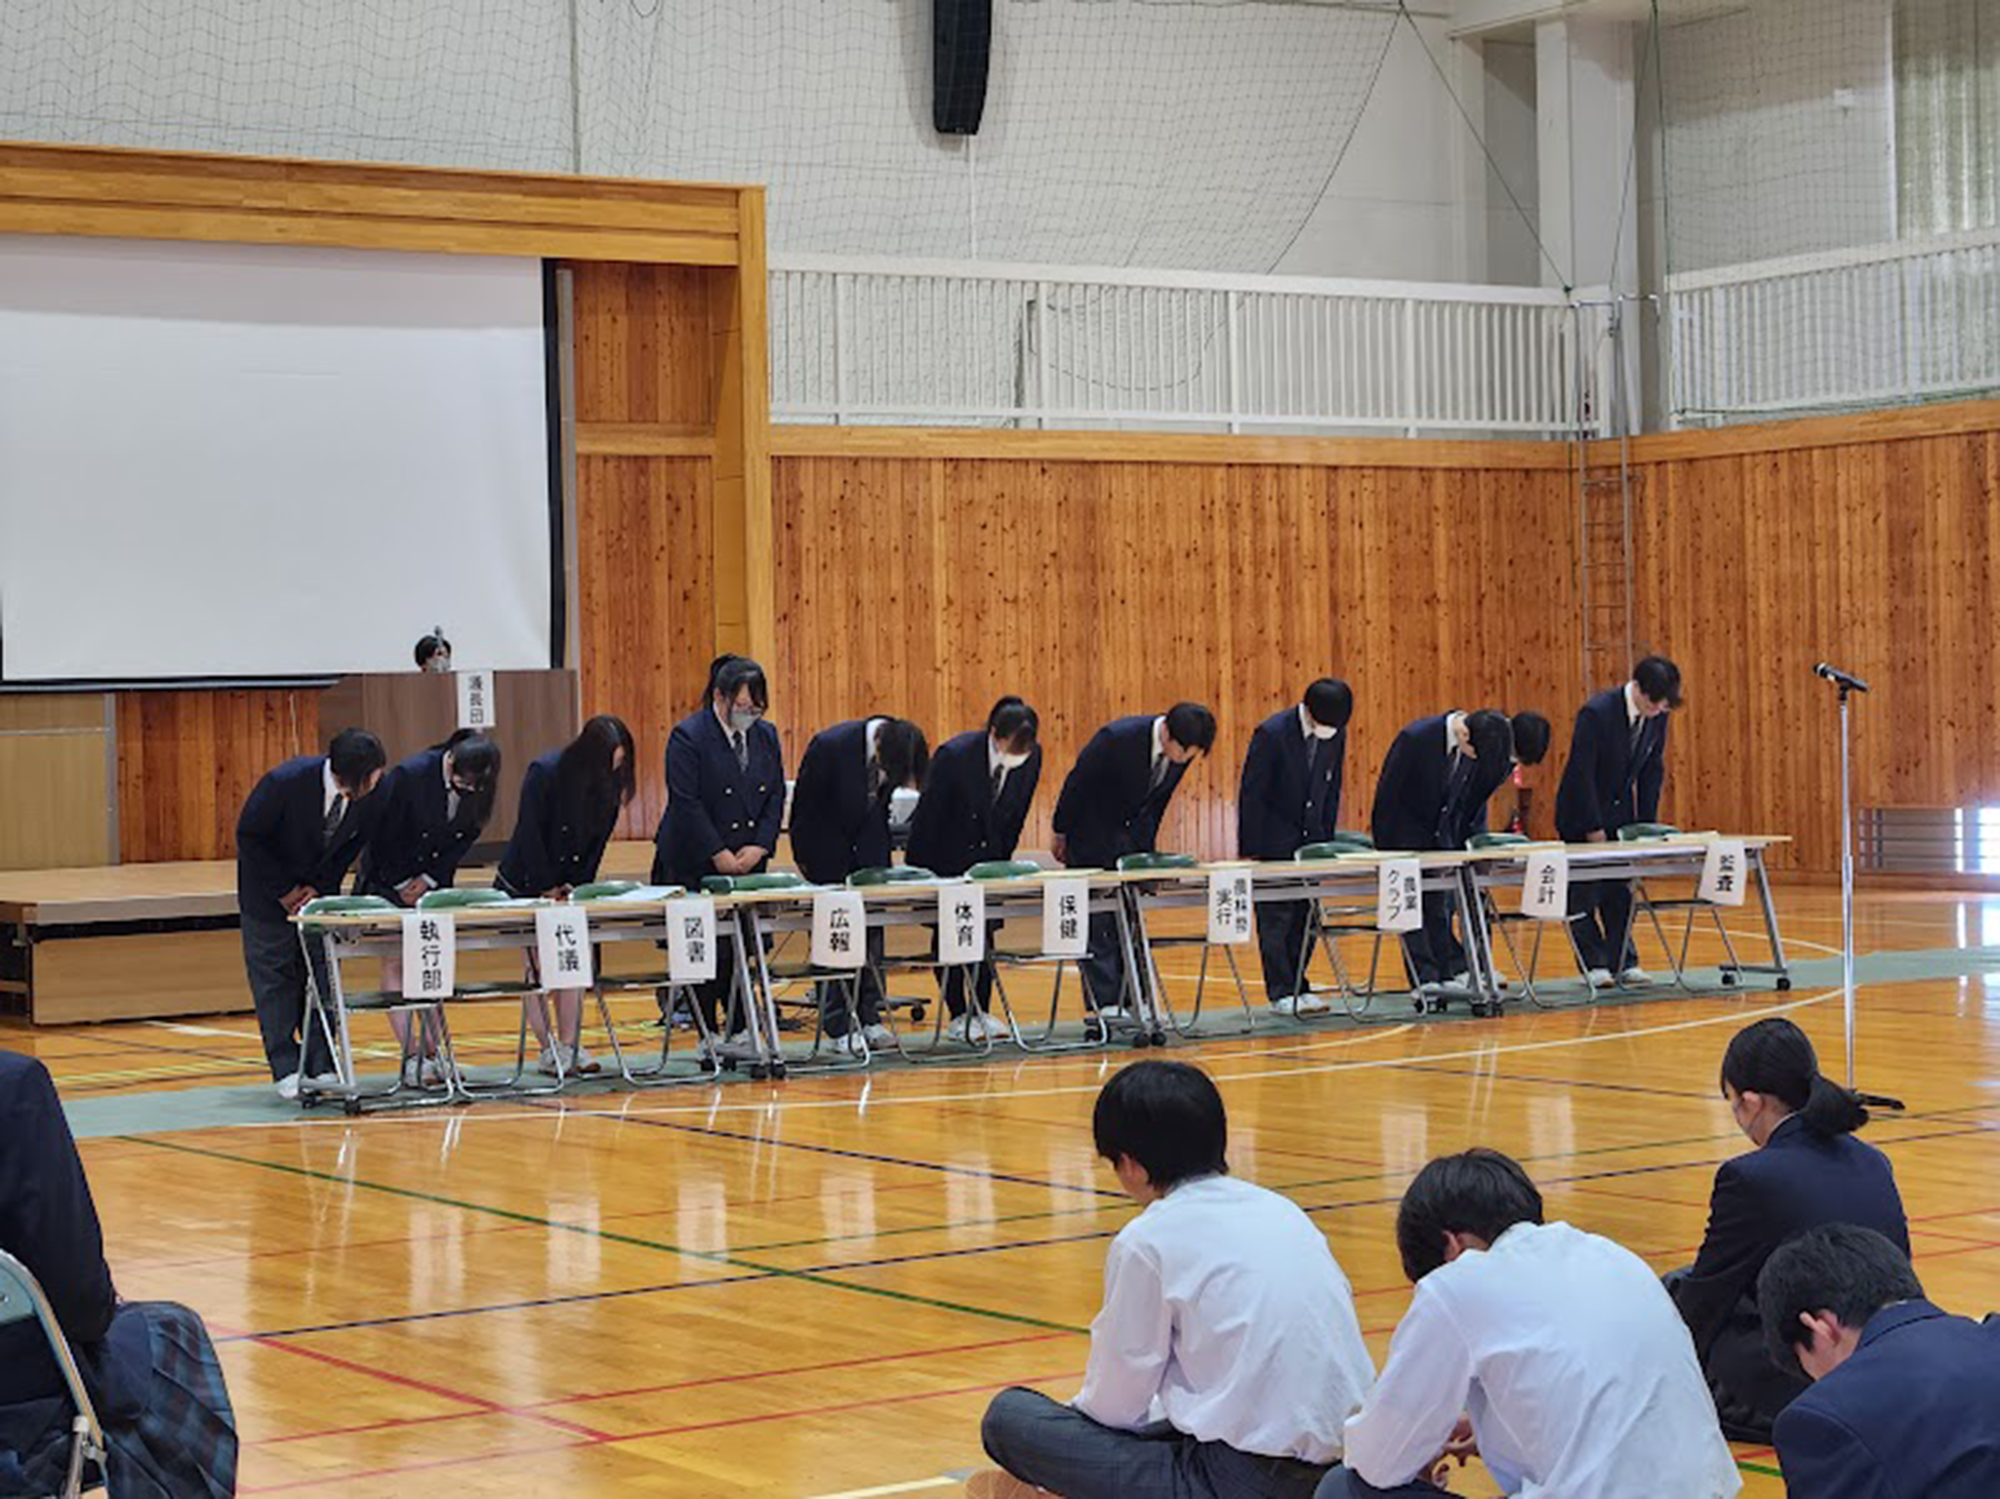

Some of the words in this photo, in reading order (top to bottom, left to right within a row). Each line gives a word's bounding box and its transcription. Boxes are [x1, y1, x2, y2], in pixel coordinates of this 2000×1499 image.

[1388, 869, 1403, 922] クラブ
[1537, 864, 1556, 904] 会計
[1715, 854, 1735, 892] 監査
[829, 907, 851, 952] 広報
[954, 903, 973, 947] 体育
[1060, 894, 1078, 939] 保健
[1216, 888, 1232, 926] 実行
[419, 920, 442, 991] 執行部
[554, 924, 579, 971] 代議
[684, 916, 705, 963] 図書
